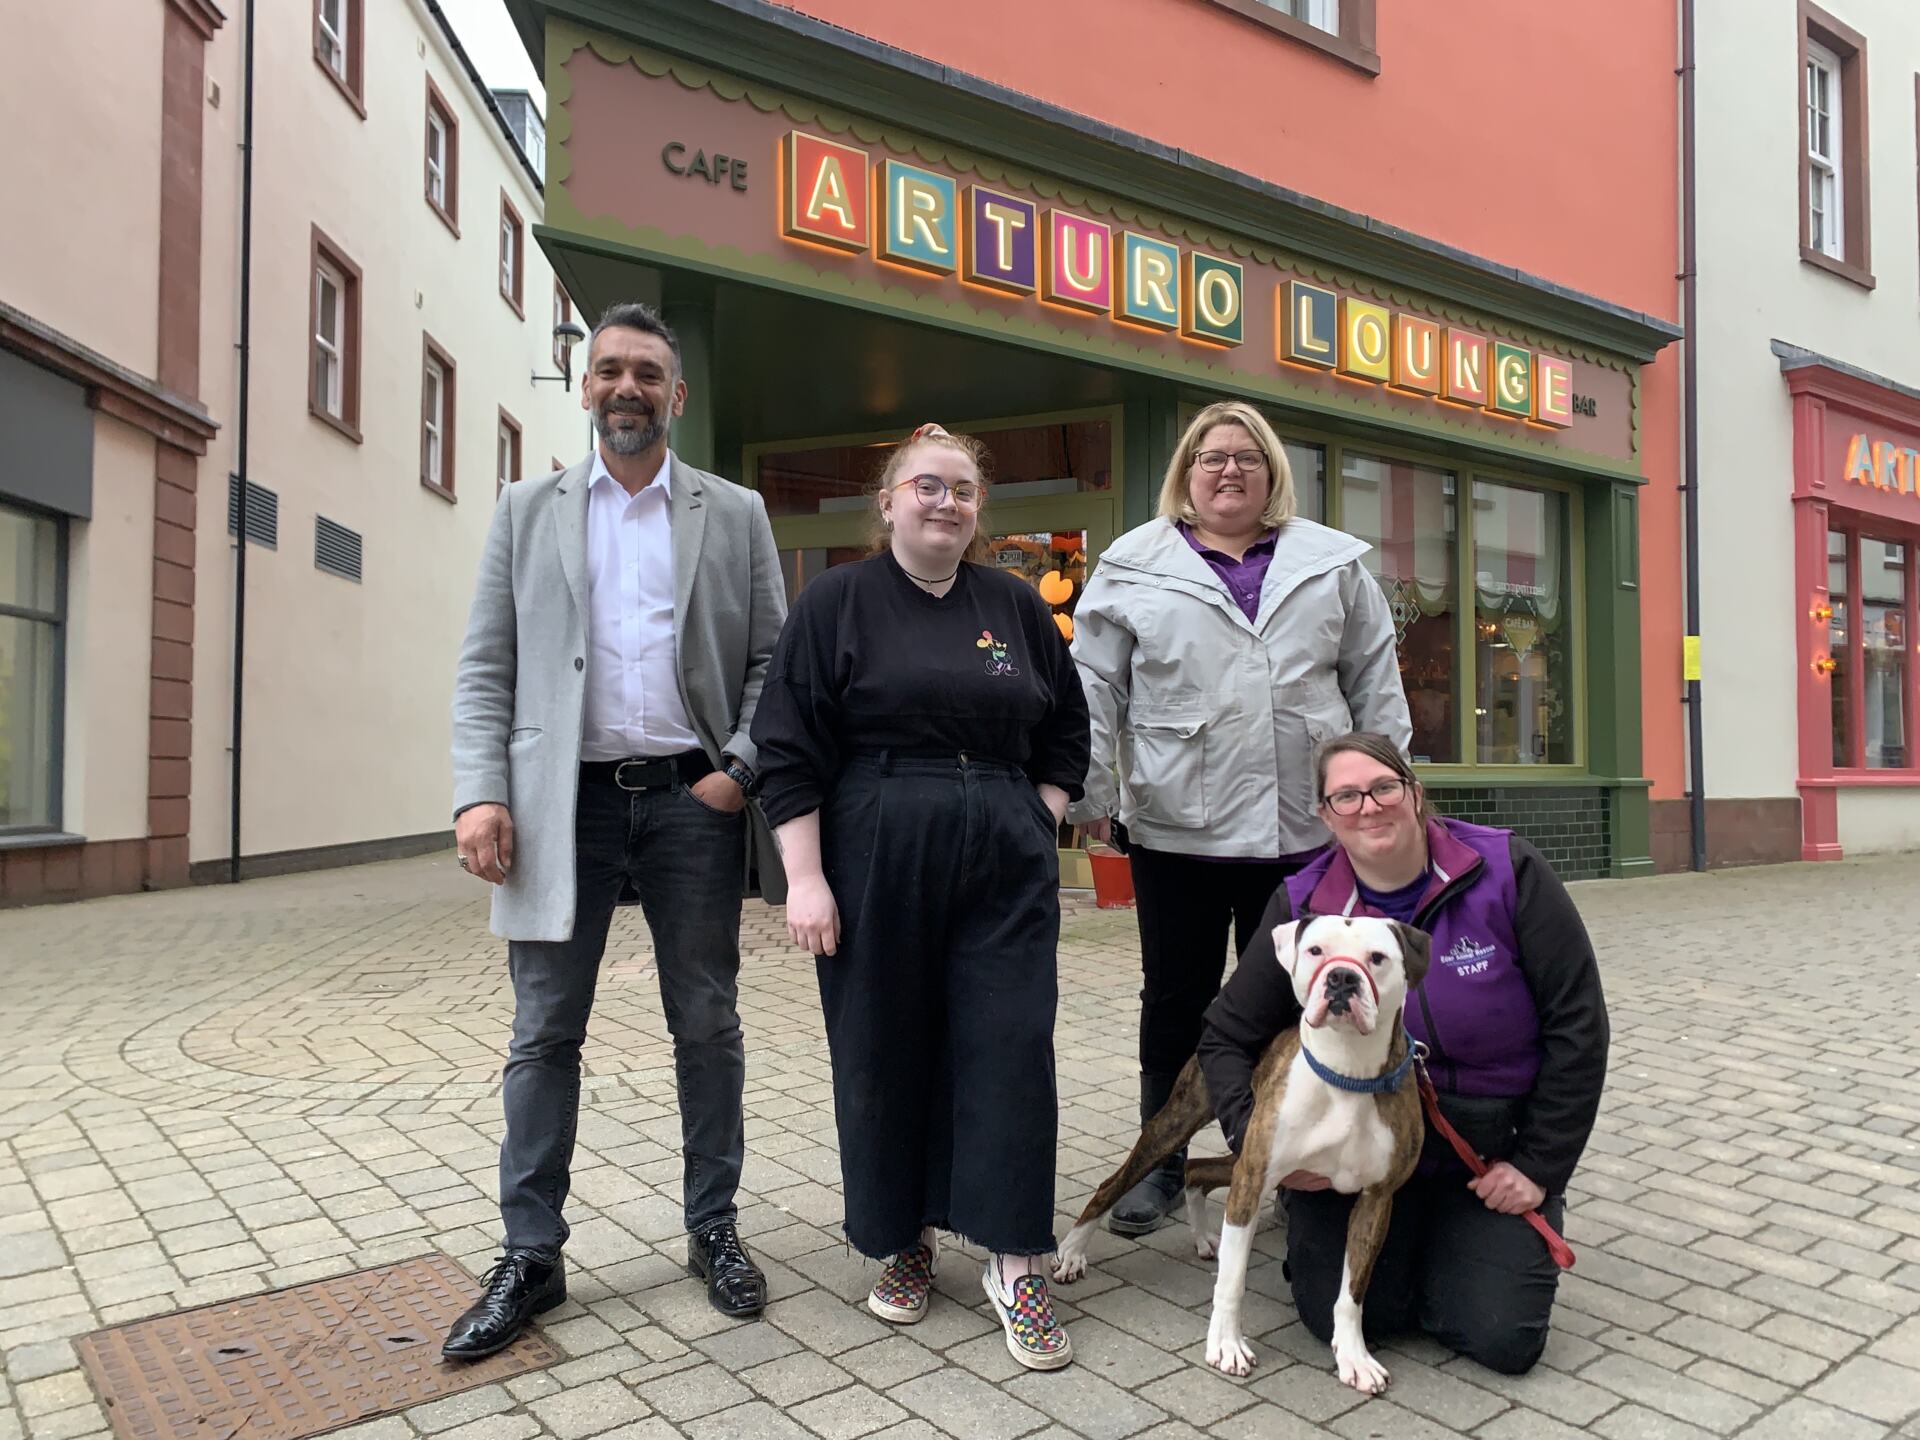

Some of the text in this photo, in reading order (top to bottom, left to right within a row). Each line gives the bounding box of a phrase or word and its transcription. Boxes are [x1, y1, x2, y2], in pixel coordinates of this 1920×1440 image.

[662, 141, 1597, 417] CAFE ARTURO LOUNGE BAR
[1844, 433, 1920, 495] ART
[1457, 960, 1488, 976] STAFF
